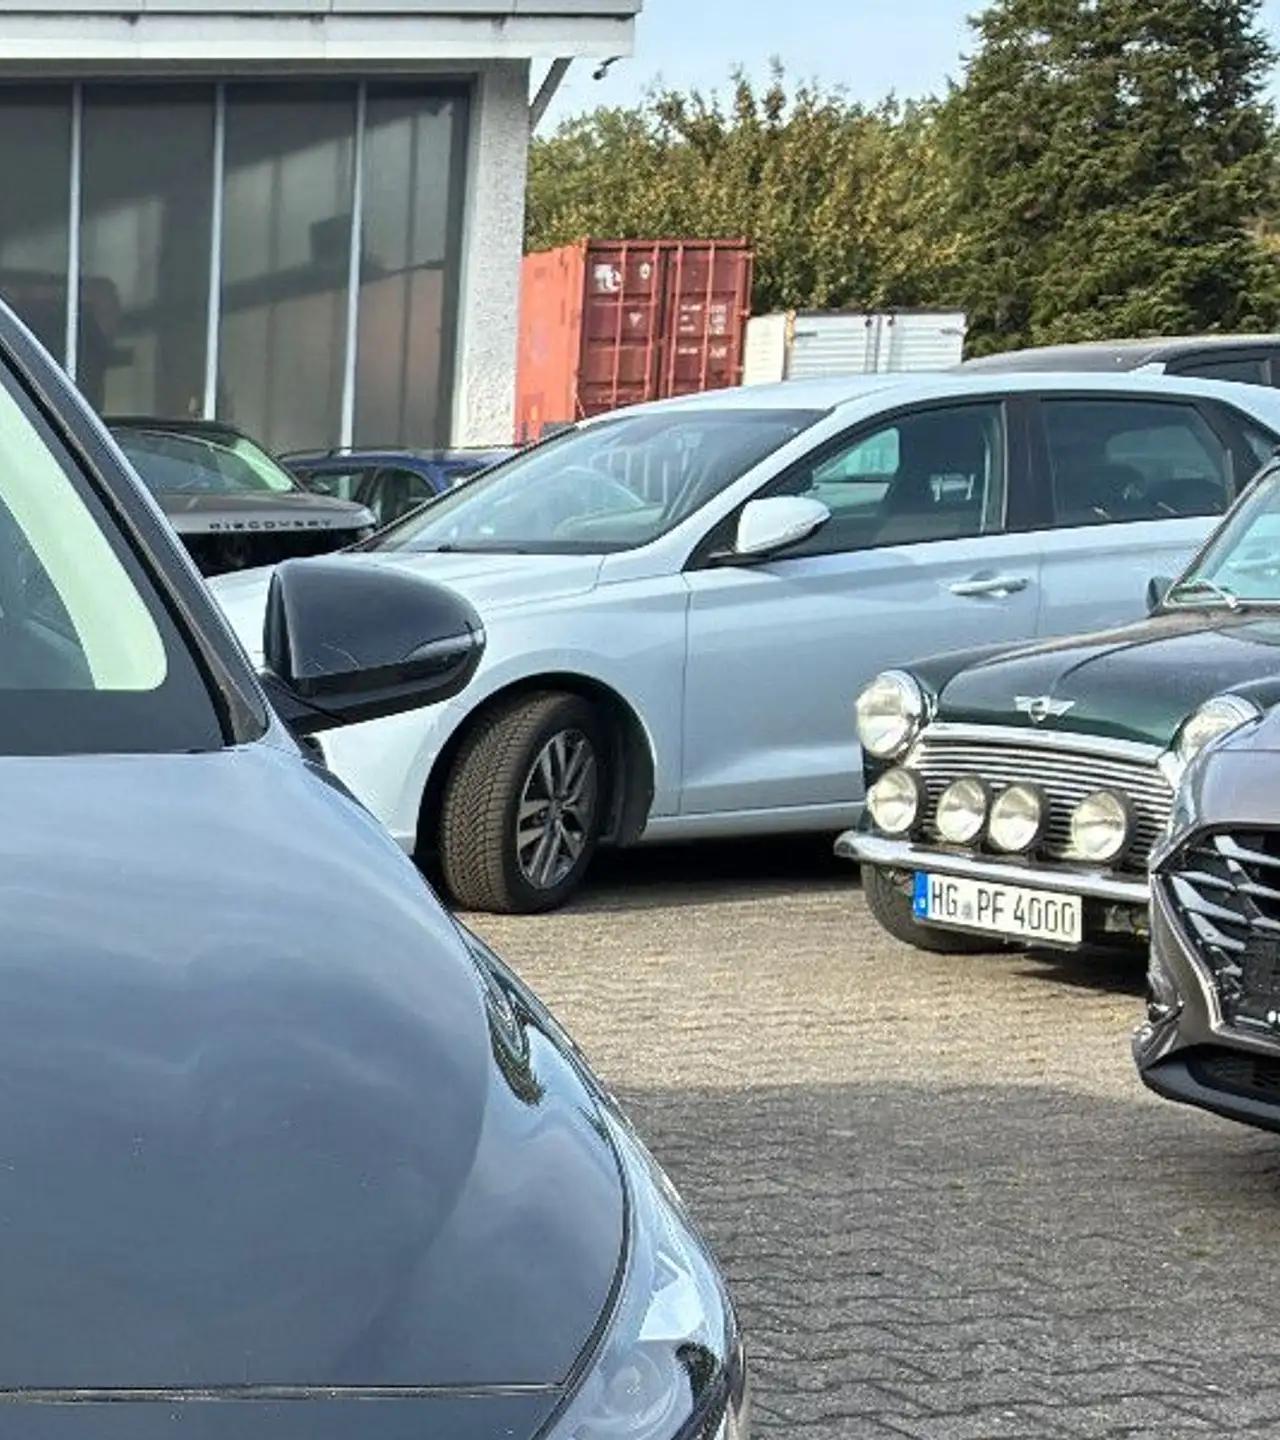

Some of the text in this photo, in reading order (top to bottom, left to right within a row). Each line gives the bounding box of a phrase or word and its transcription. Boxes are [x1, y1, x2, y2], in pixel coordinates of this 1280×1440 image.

[931, 880, 1075, 936] HG PF 4000
